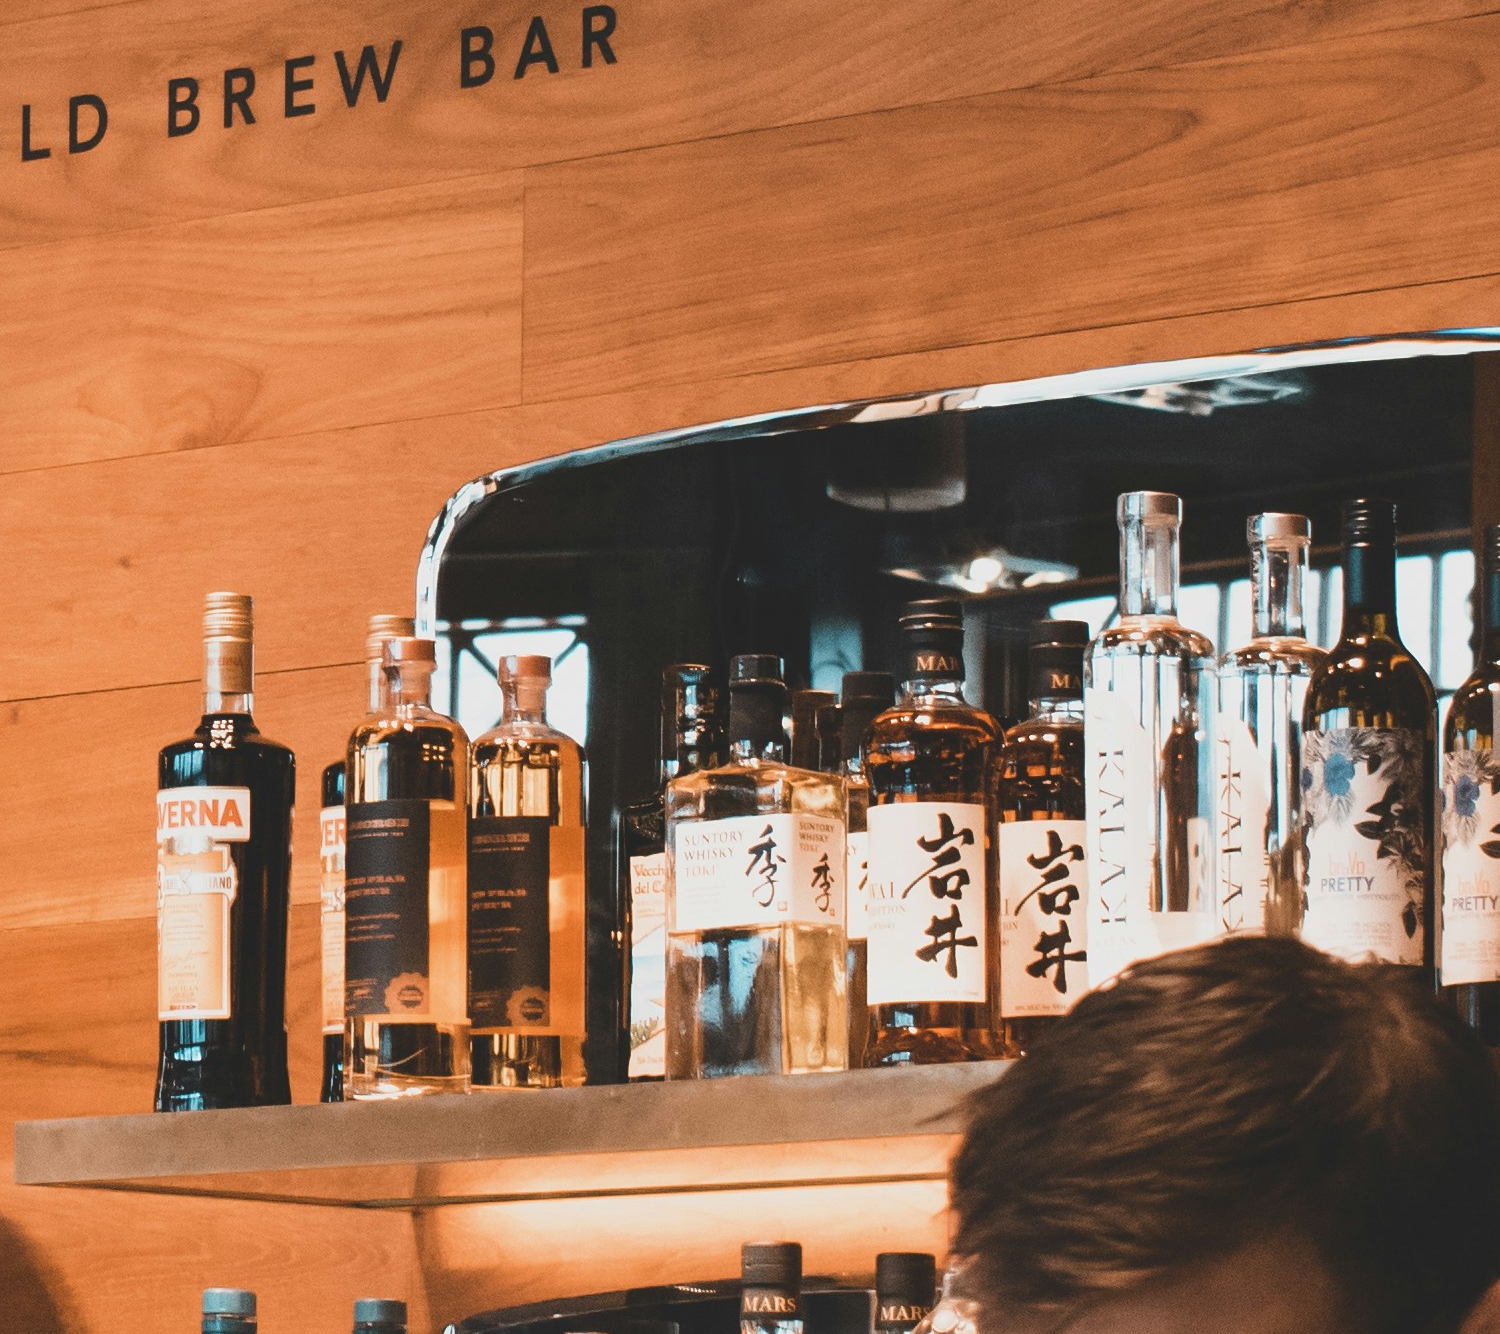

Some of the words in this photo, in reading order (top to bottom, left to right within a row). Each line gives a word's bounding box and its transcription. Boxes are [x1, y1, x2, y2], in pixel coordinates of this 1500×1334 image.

[167, 39, 404, 139] BREW
[459, 3, 619, 90] BAR
[683, 830, 745, 845] SUNTORY
[683, 846, 735, 862] WHISKY
[1320, 876, 1375, 893] PRETTY
[901, 812, 979, 980] 岩井
[1452, 895, 1498, 911] PRETTY
[743, 1296, 796, 1313] MARS
